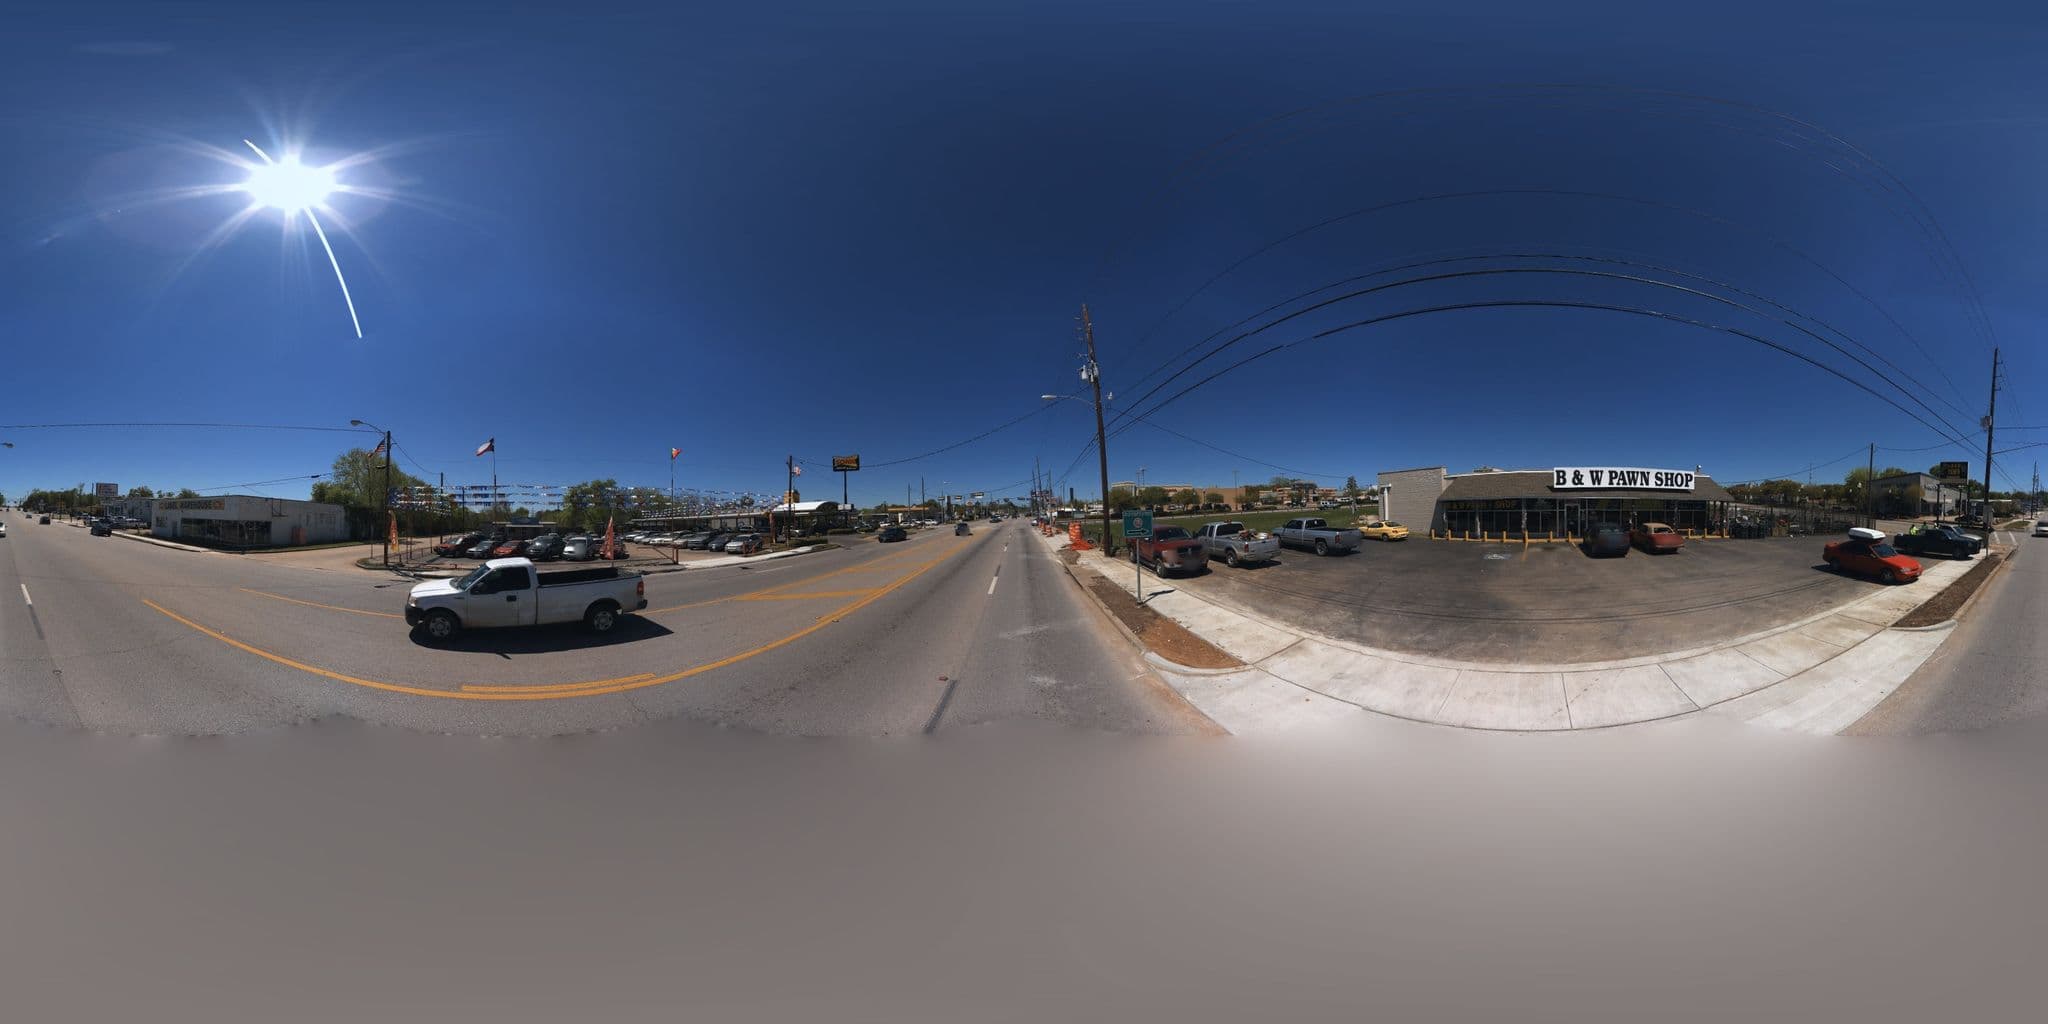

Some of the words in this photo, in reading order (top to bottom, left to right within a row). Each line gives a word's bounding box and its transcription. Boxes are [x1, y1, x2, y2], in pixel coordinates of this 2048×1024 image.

[1555, 470, 1567, 486] B
[1571, 469, 1585, 486] &
[1589, 470, 1604, 486] W
[1608, 470, 1651, 487] PAWN
[1654, 471, 1694, 488] SHOP
